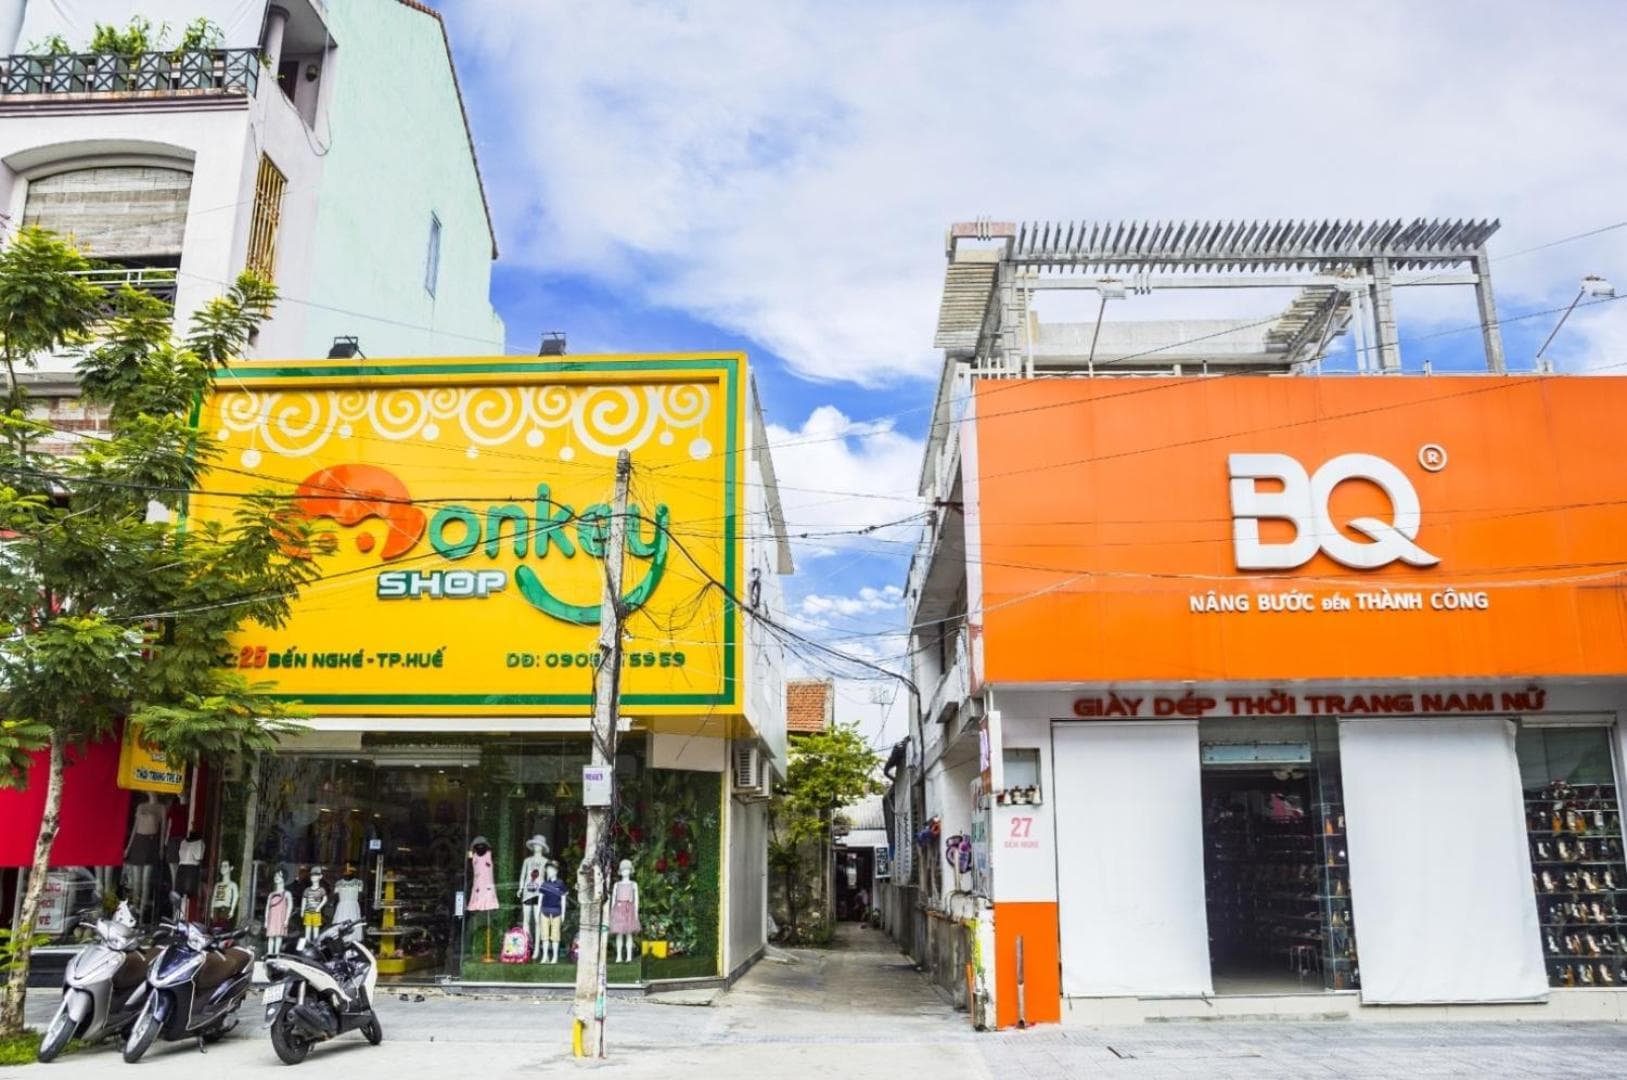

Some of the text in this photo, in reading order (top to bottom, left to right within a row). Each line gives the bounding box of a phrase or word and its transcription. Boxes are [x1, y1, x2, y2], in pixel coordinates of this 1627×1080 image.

[1227, 452, 1442, 570] BQ
[376, 570, 508, 600] SHOP
[1190, 590, 1250, 613] NÂNG
[1257, 588, 1315, 612] BƯỚC
[1356, 588, 1423, 611] THÀNH
[1430, 586, 1489, 610] CÔNG
[1073, 689, 1144, 717] GIÀY
[1304, 692, 1414, 714] TRANG
[1420, 691, 1495, 713] NAM
[1010, 816, 1033, 838] 27
